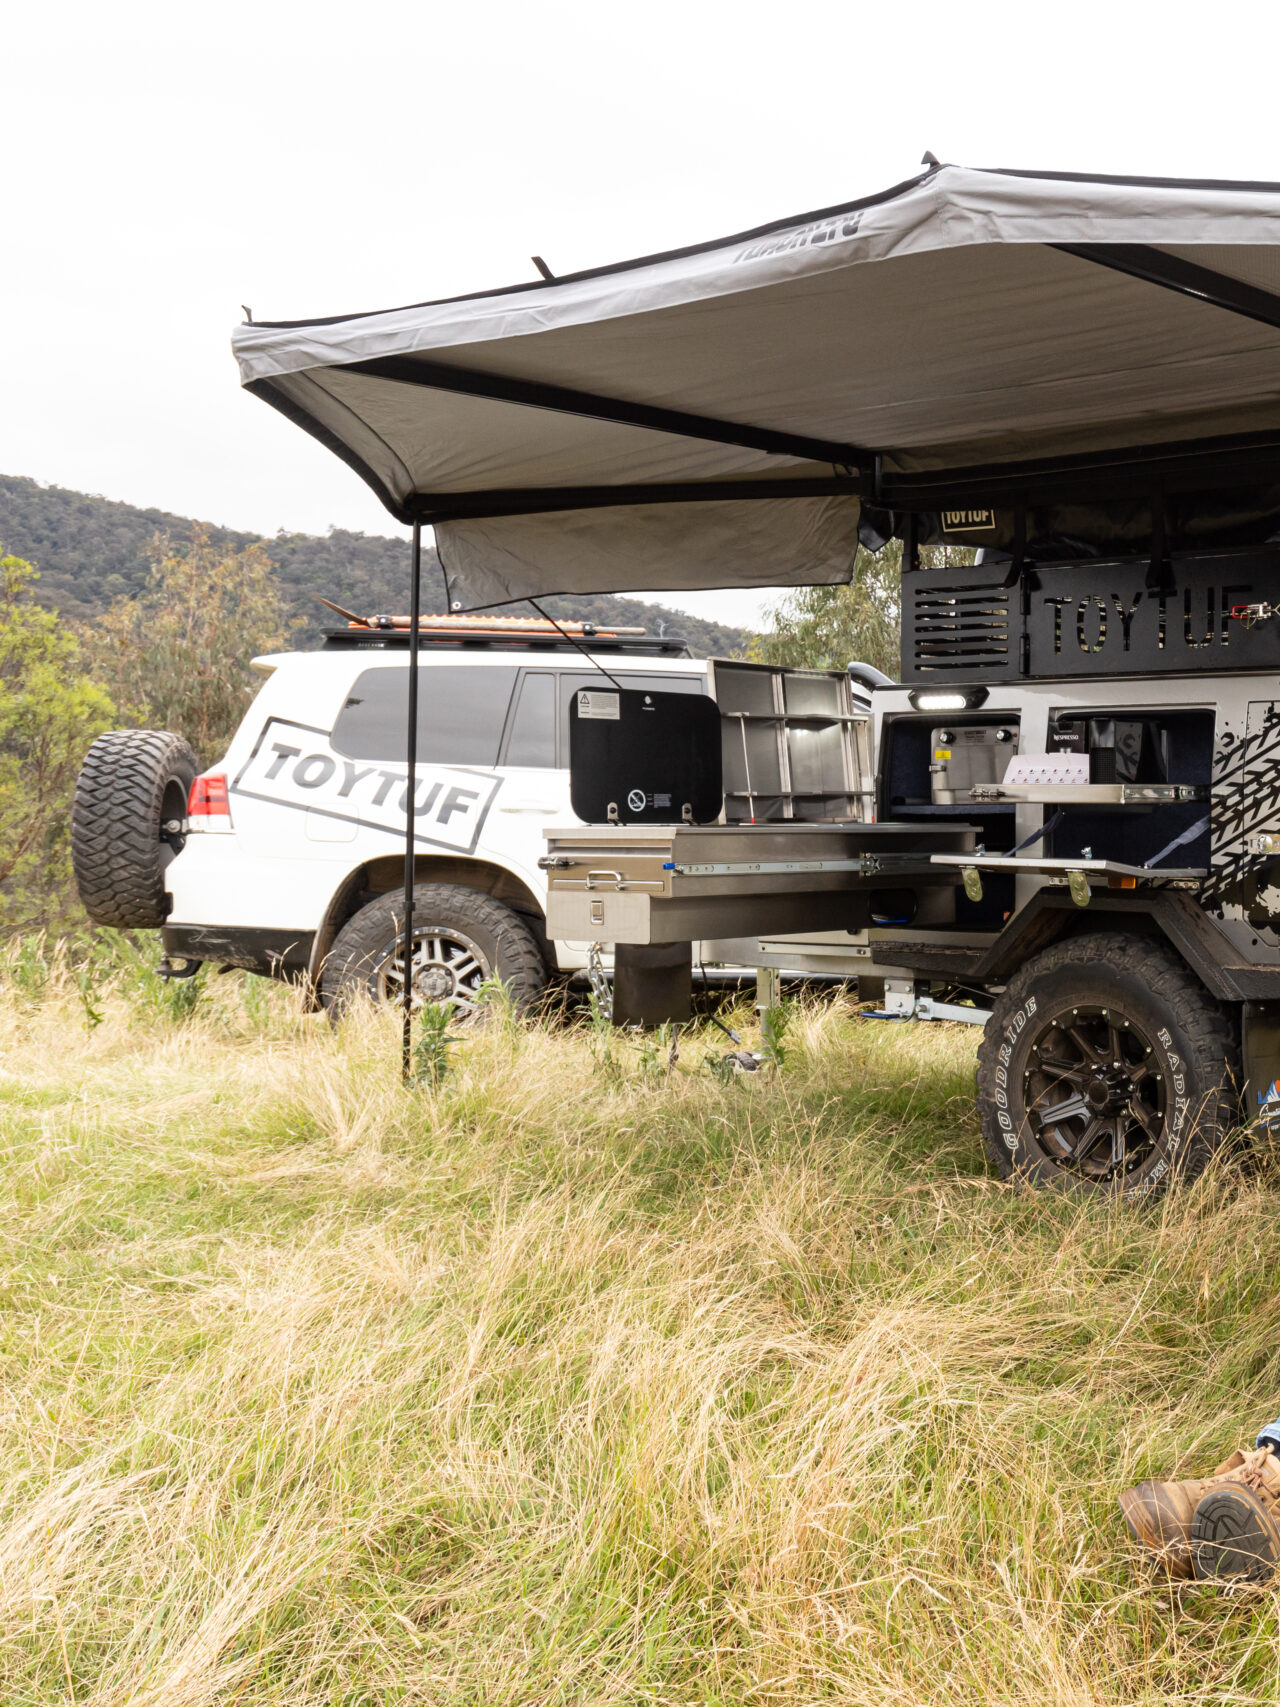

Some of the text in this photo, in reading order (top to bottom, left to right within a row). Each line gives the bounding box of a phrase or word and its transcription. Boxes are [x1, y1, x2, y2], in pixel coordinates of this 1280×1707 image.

[945, 509, 989, 524] TOYTUF
[1043, 584, 1253, 656] TOYTUF
[264, 742, 480, 825] TOYTUF
[994, 996, 1038, 1150] GOODRIDE
[1157, 1027, 1188, 1152] RADIAL
